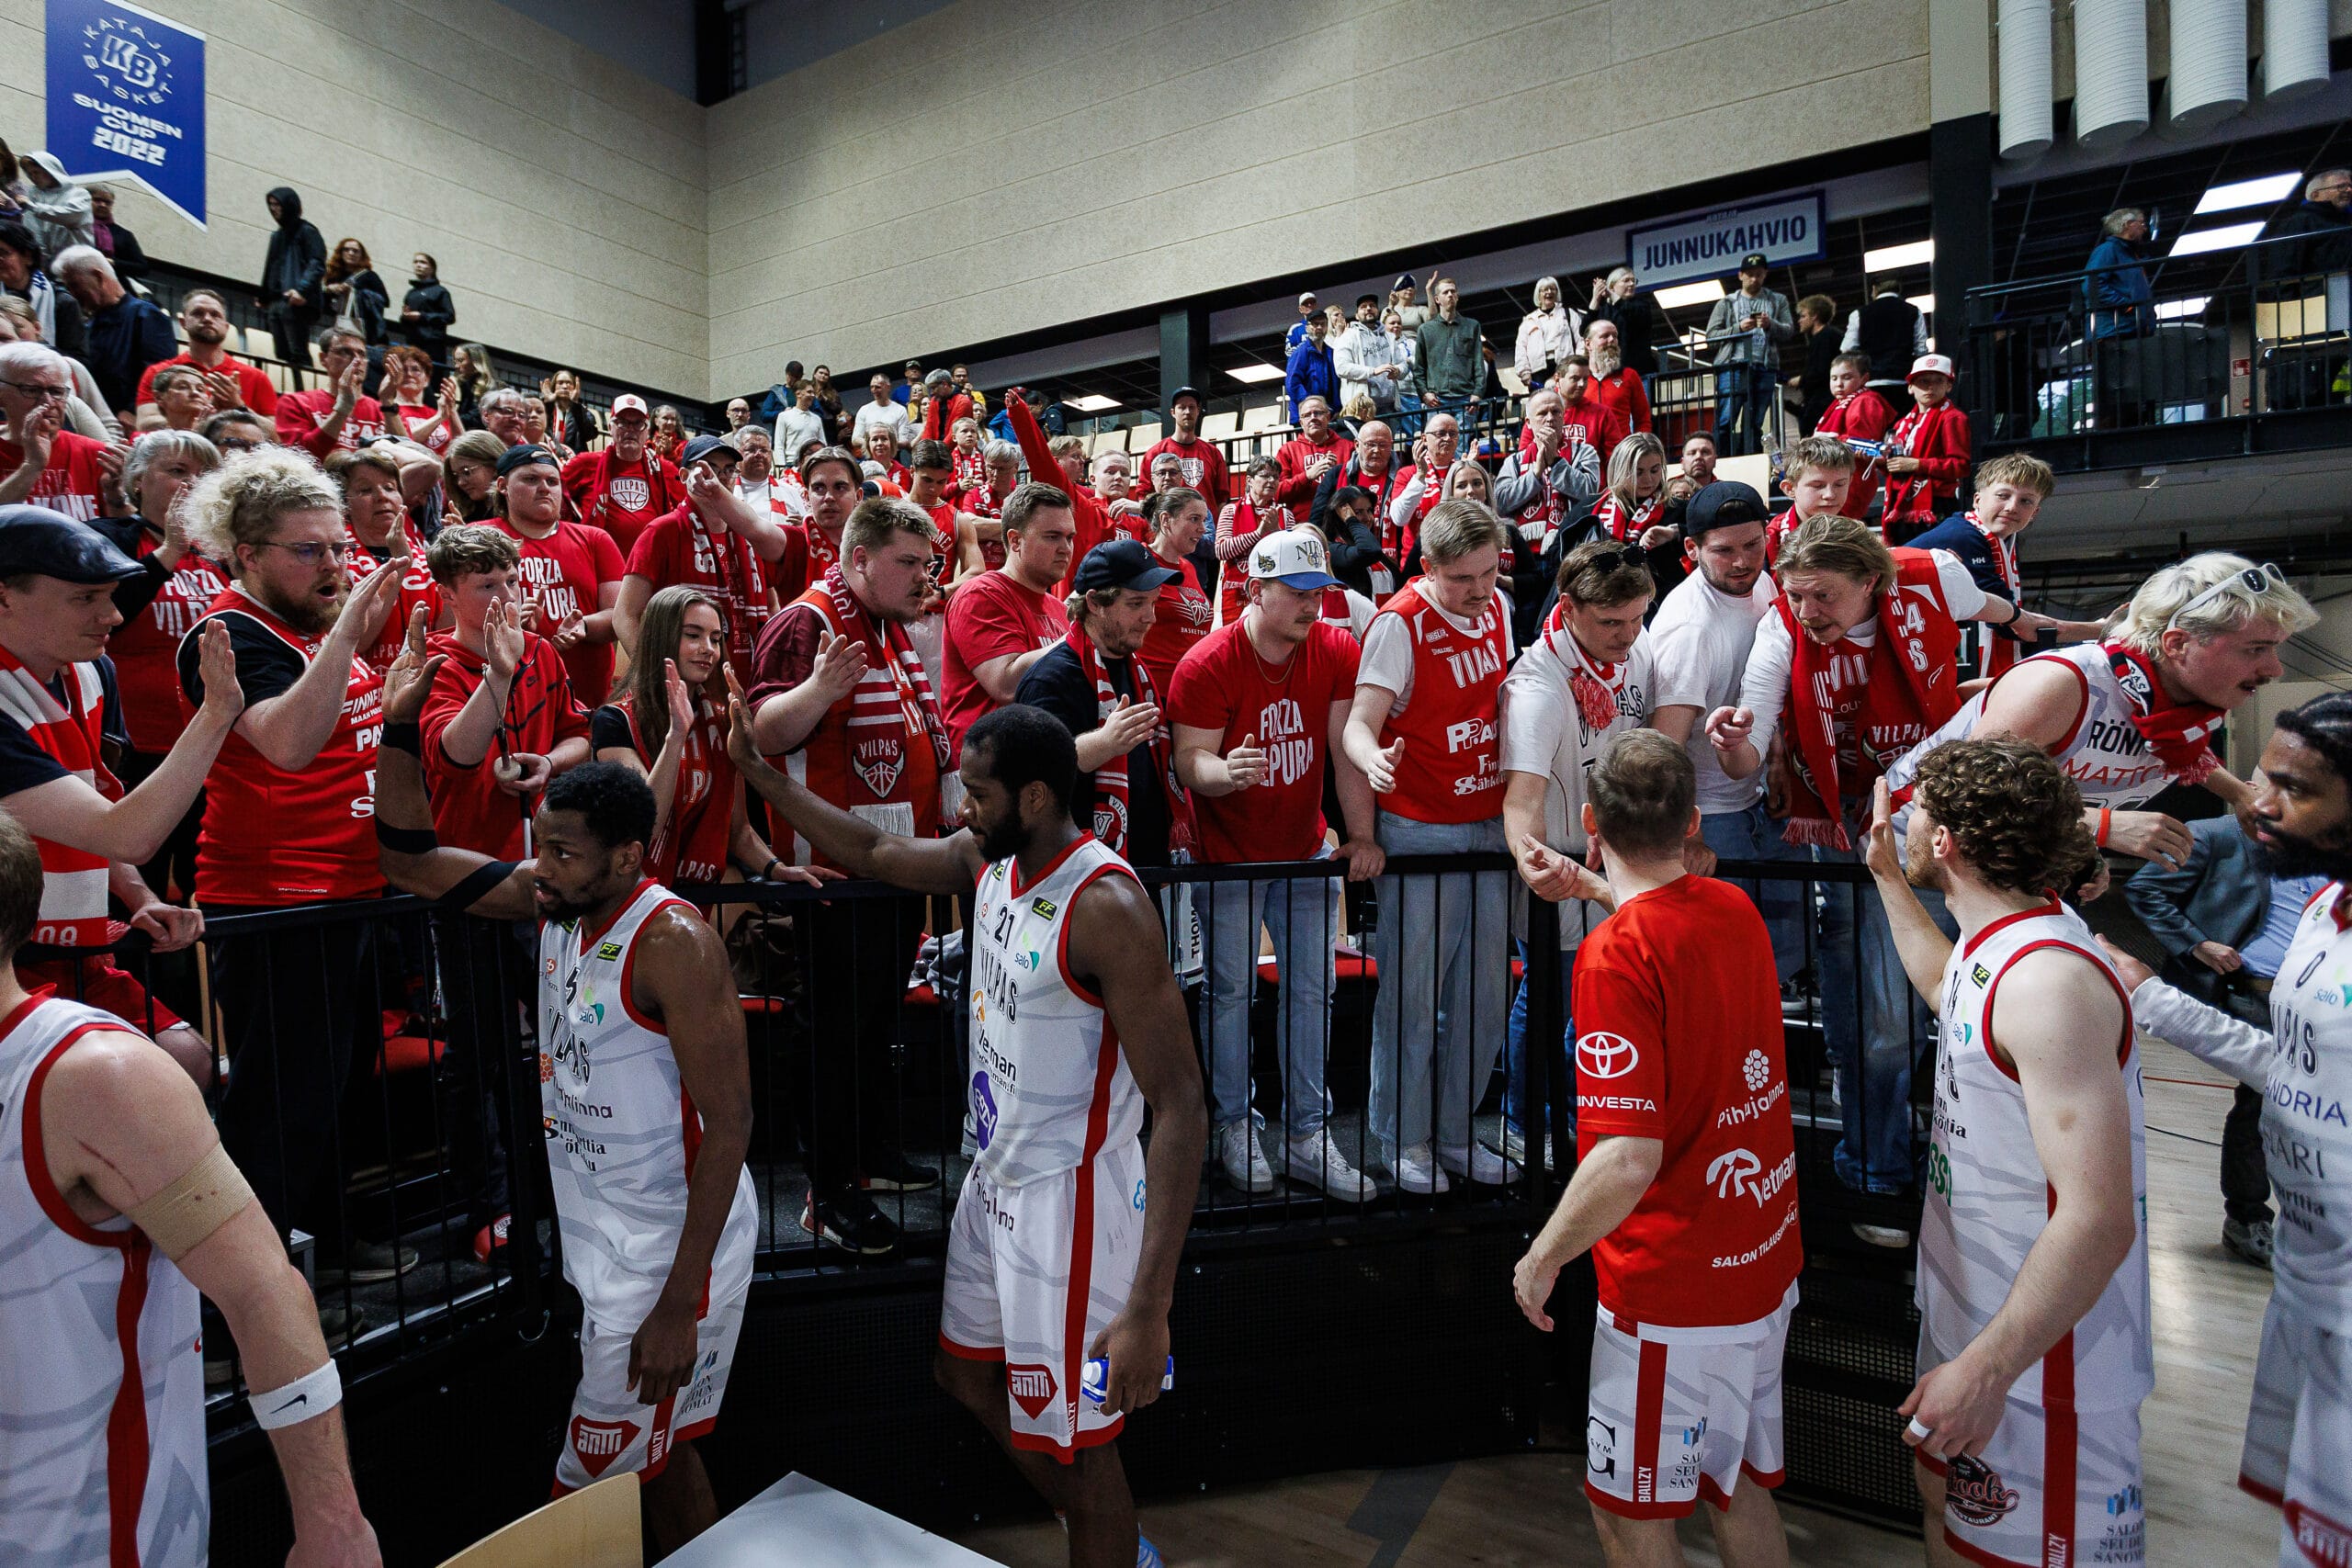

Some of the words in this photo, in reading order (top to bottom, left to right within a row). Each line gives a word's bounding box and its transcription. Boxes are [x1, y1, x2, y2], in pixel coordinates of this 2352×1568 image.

[83, 17, 172, 67] KATAJA
[100, 34, 158, 88] KB
[82, 54, 173, 107] BASKET
[73, 92, 183, 140] SUOMEN
[101, 115, 157, 140] CUP
[92, 126, 167, 167] 2022
[1643, 215, 1807, 272] JUNNUKAHVIO
[613, 479, 645, 493] VILPAS
[164, 569, 226, 597] FORZA
[517, 557, 564, 585] FORZA
[151, 600, 213, 639] VILP
[1181, 626, 1209, 636] BASKETBA
[1260, 698, 1305, 741] FORZA
[858, 739, 899, 759] VILPAS
[993, 903, 1016, 952] 21
[1014, 952, 1030, 969] salo
[979, 943, 1019, 1025] VILPAS
[2313, 987, 2338, 1006] salo
[1747, 1151, 1796, 1209] Vetman
[1711, 1249, 1758, 1269] SALON
[1637, 1465, 1653, 1504] BALLZY
